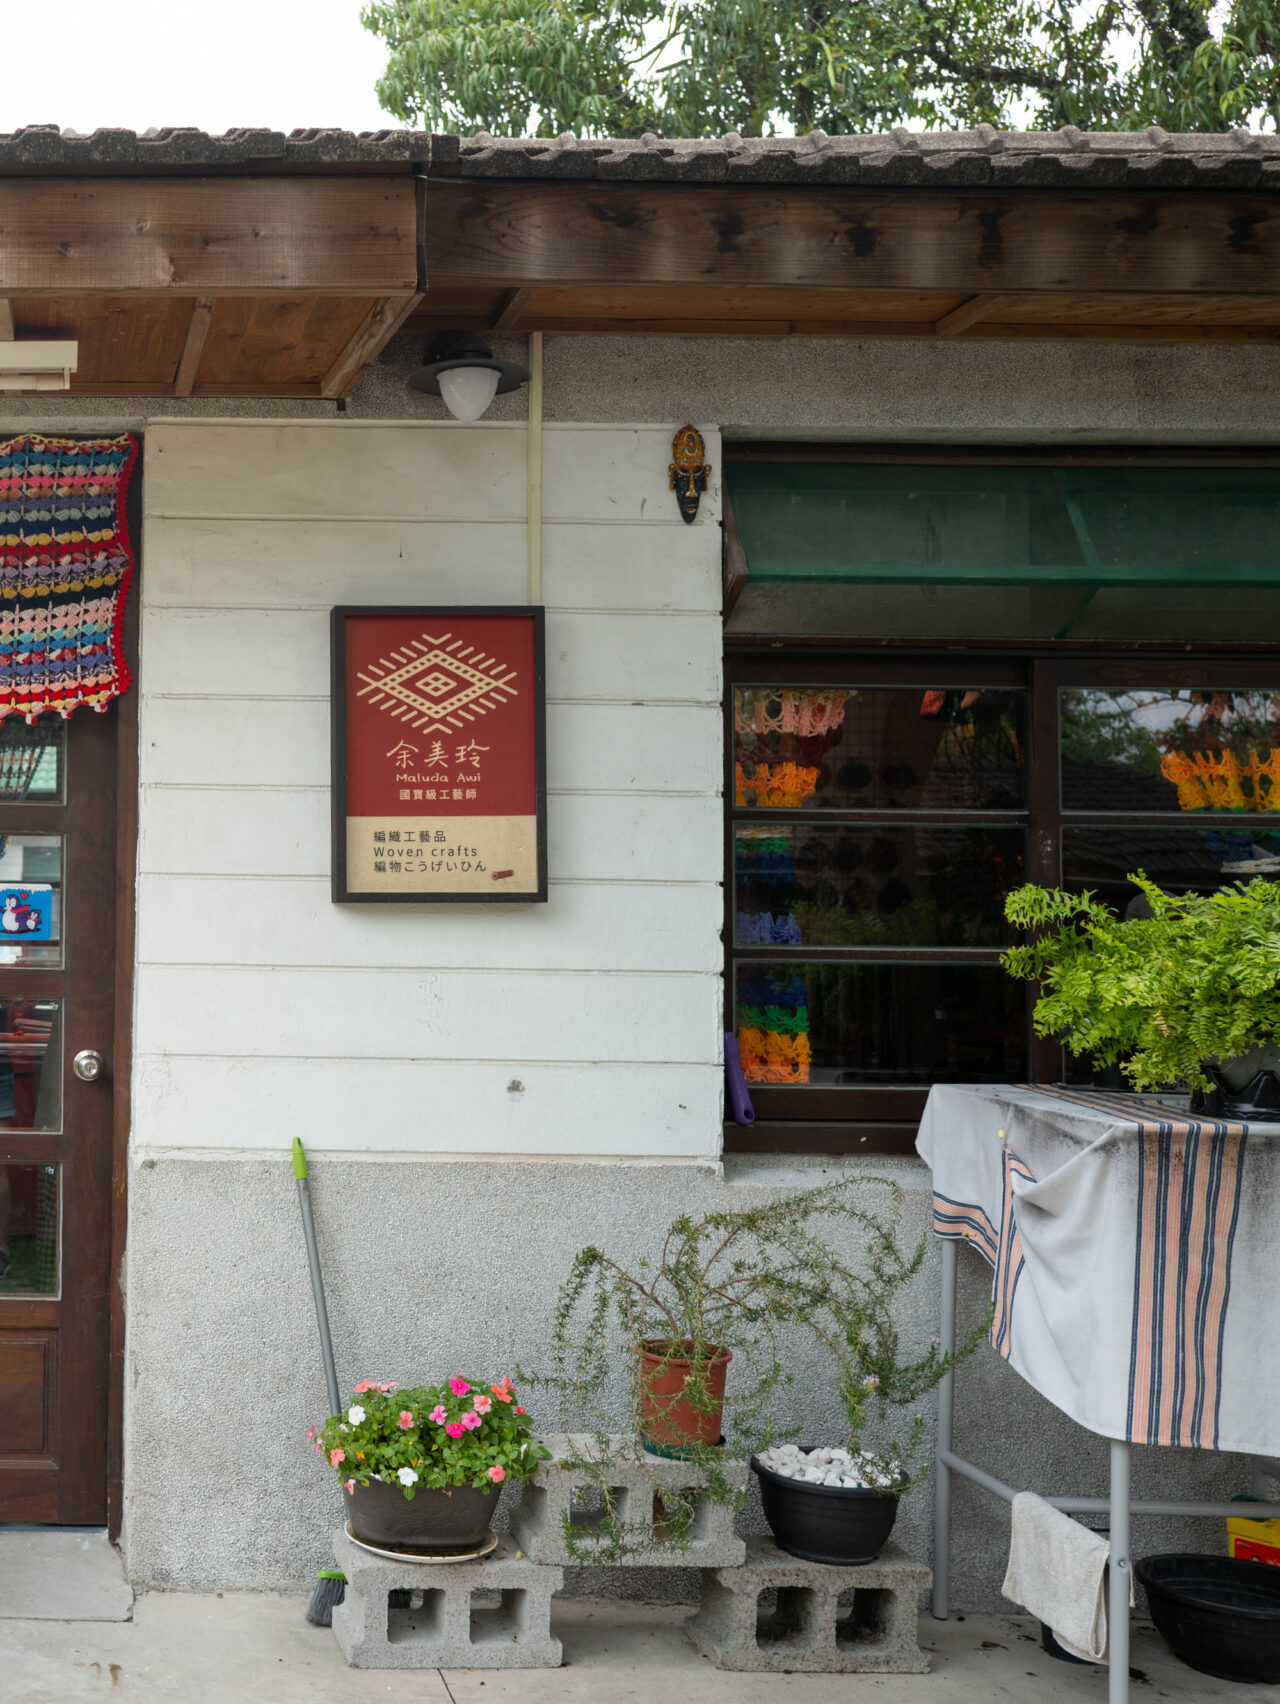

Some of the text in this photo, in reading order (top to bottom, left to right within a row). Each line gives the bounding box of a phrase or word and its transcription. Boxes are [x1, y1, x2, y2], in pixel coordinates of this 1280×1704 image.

[386, 739, 490, 768] 余美玲
[396, 772, 481, 783] Maluda Awi
[399, 789, 477, 800] 國寶級工藝師
[373, 830, 446, 843] 編織工藝品
[373, 845, 478, 857] Woven crafts
[373, 860, 487, 873] 編物こうげいひん
